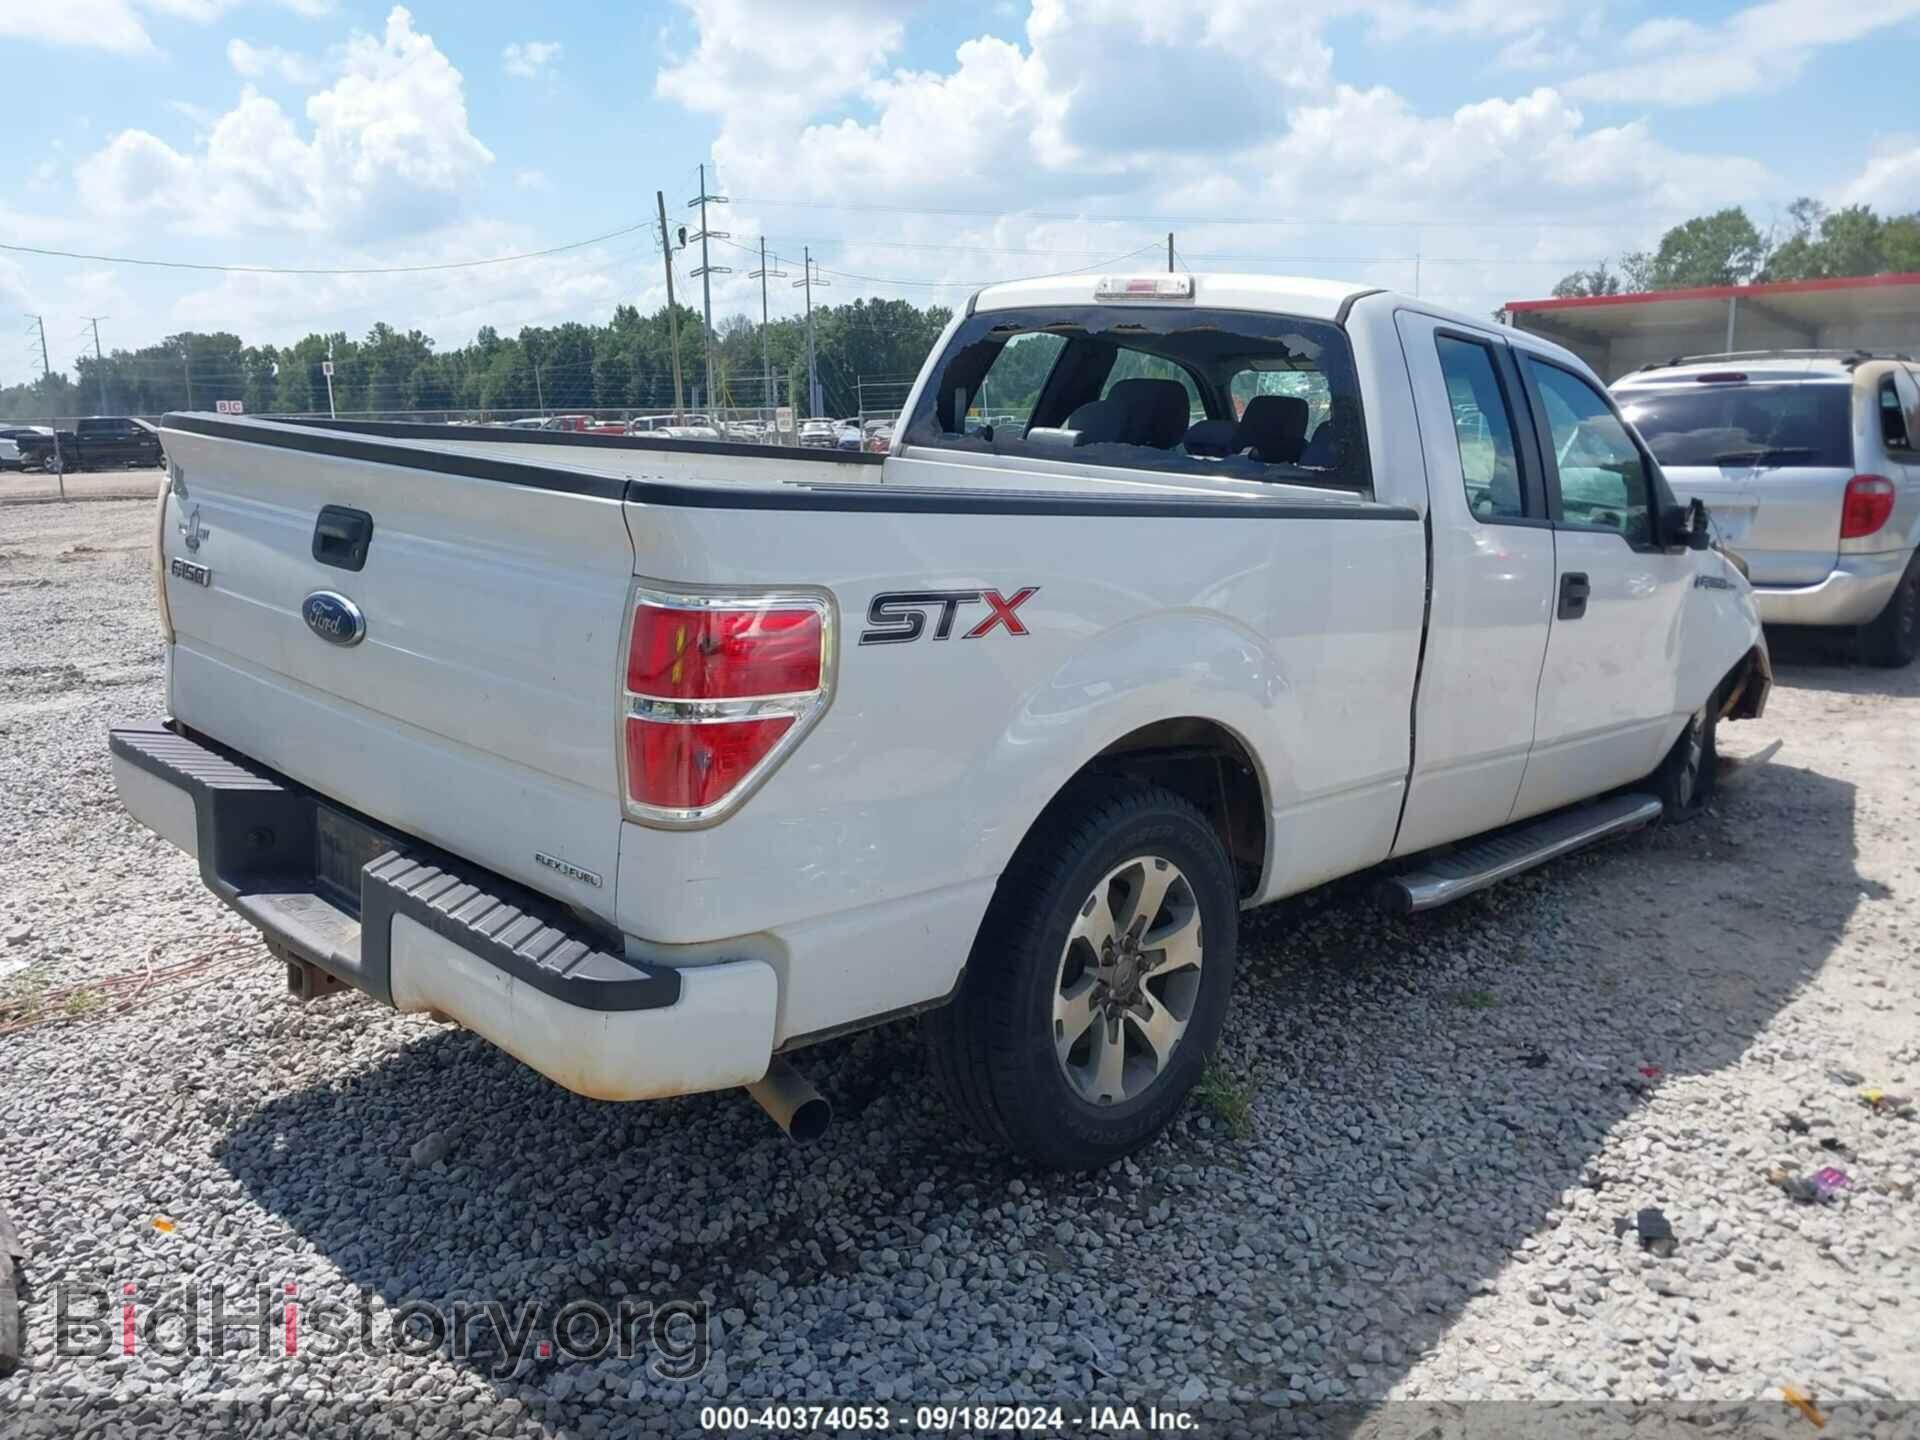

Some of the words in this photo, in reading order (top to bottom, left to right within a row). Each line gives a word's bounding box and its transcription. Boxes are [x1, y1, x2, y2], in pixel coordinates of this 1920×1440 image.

[309, 600, 342, 634] Ford
[858, 587, 1041, 646] STX
[569, 866, 599, 887] FUEL
